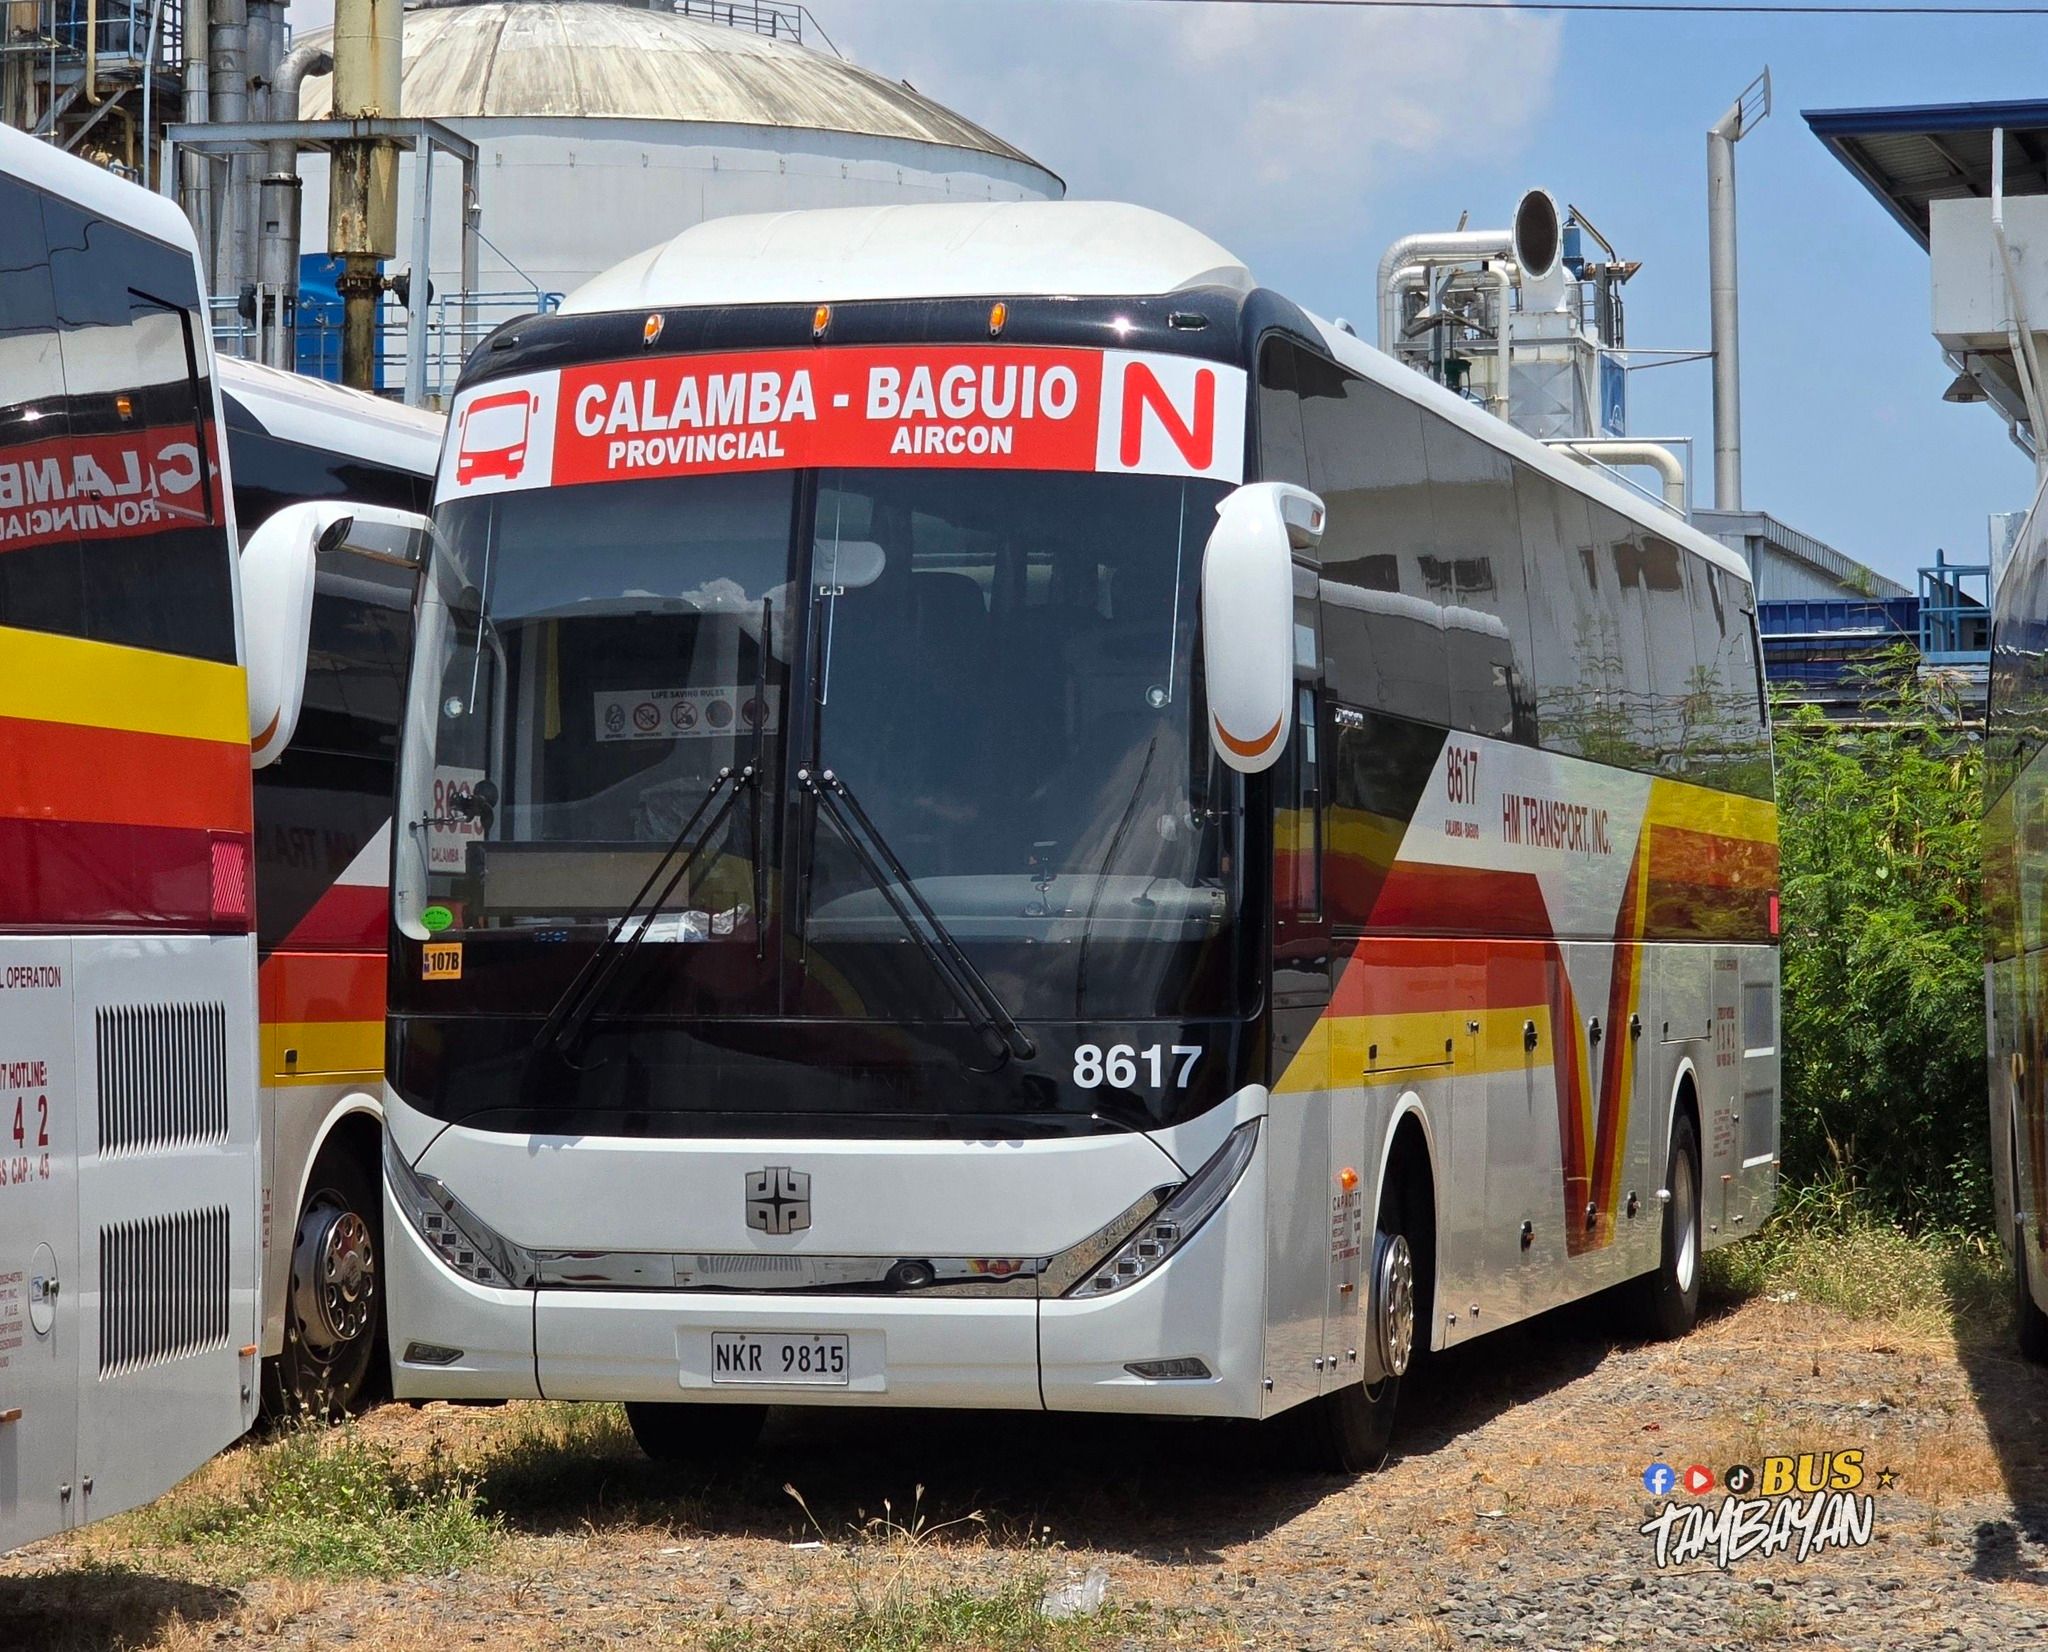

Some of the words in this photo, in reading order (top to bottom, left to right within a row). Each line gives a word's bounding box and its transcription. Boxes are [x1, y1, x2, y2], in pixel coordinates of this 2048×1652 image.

[574, 370, 817, 437] CALAMBA
[866, 365, 1078, 420] BAGUIO
[1120, 361, 1216, 470] N
[608, 430, 785, 470] PROVINCIAL
[890, 425, 1013, 456] AIRCON
[1447, 746, 1478, 806] 8617
[1503, 793, 1521, 845] HM
[1523, 797, 1590, 861] TRANSPORT,
[1592, 809, 1612, 855] INC.
[6, 966, 61, 988] OPERATION
[430, 951, 460, 971] 107B
[9, 1061, 47, 1089] HOTLINE:
[1073, 1044, 1202, 1089] 8617
[39, 1153, 50, 1180] 45
[1333, 1192, 1362, 1211] CAPACITY
[716, 1344, 762, 1371] NKR
[782, 1345, 844, 1373] 9815
